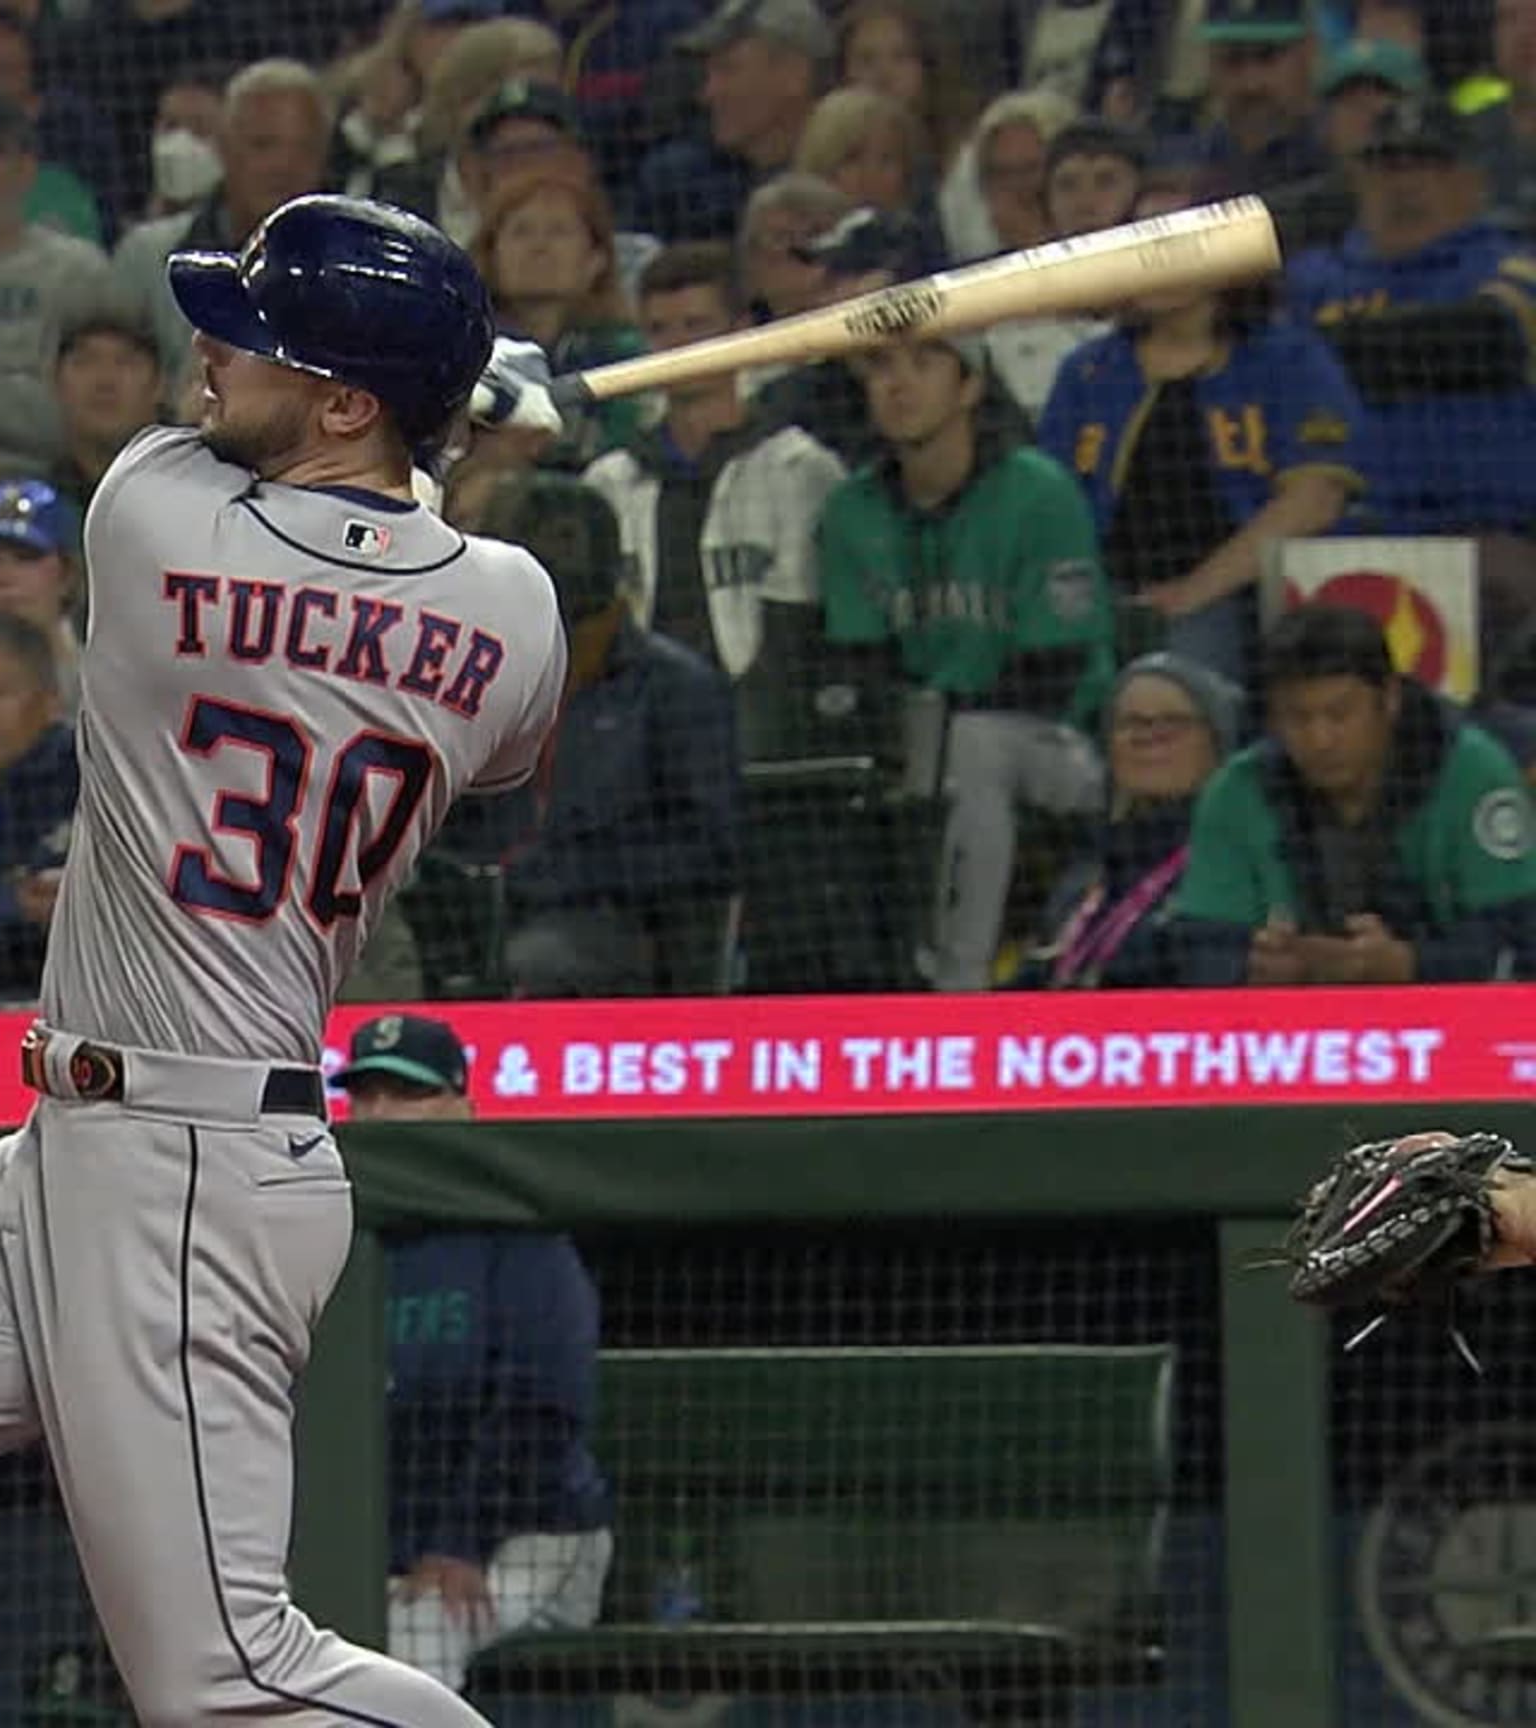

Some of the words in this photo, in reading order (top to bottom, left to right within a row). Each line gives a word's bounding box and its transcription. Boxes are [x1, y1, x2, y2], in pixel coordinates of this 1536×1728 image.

[163, 571, 506, 722] TUCKER
[168, 692, 434, 935] 30
[494, 1043, 539, 1096] &
[564, 1038, 734, 1095] BEST
[751, 1037, 823, 1092] IN
[841, 1035, 978, 1091] THE
[996, 1028, 1444, 1089] NORTHWEST
